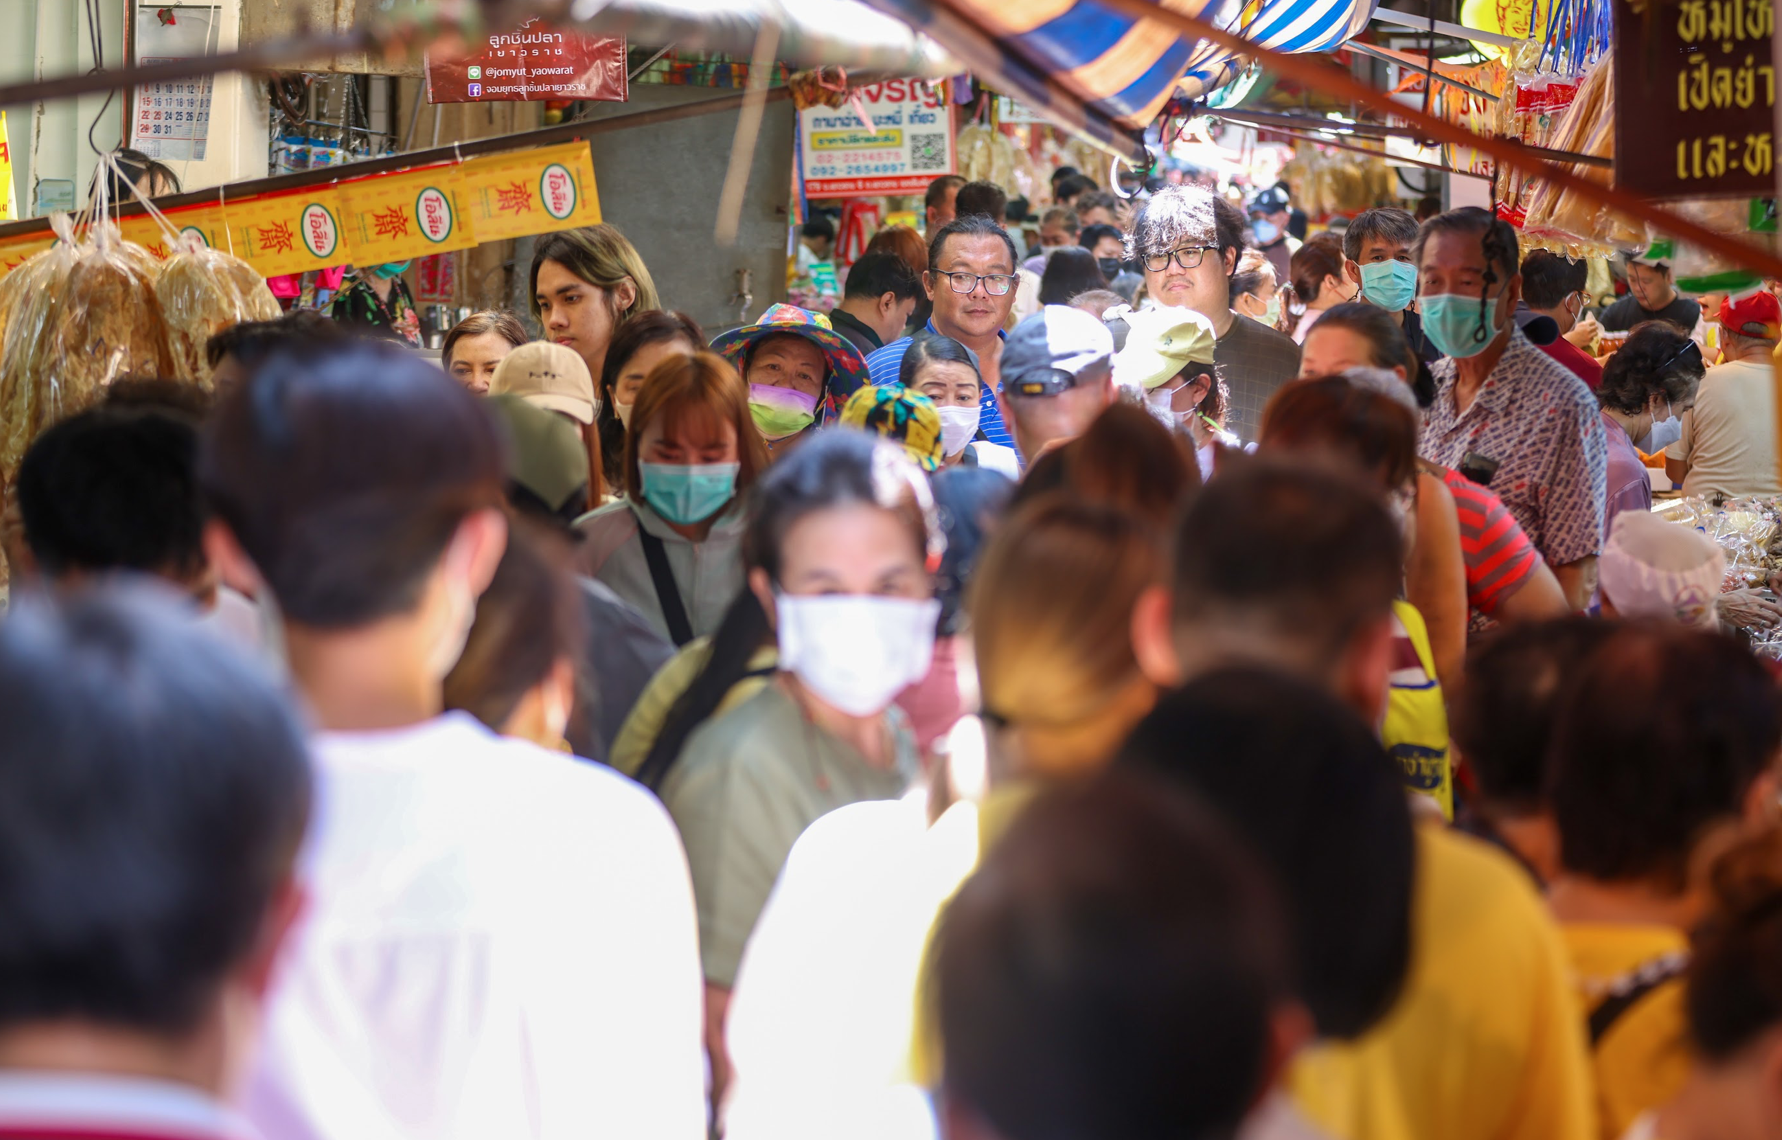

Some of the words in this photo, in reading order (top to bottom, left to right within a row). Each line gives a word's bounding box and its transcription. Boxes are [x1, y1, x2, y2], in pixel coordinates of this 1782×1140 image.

[485, 66, 574, 79] @jomyut_yaowarat
[155, 83, 160, 93] 9
[165, 84, 173, 93] 10
[176, 84, 184, 93] 11
[187, 85, 195, 94] 12
[142, 97, 151, 106] 15
[154, 97, 162, 107] 16
[165, 98, 173, 107] 17
[176, 98, 184, 107] 18
[187, 98, 195, 107] 19
[141, 110, 150, 120] 22
[153, 110, 162, 120] 23
[165, 111, 173, 121] 24
[175, 111, 183, 121] 25
[186, 111, 194, 121] 26
[140, 123, 149, 133] 29
[153, 124, 162, 134] 30
[164, 124, 172, 135] 31
